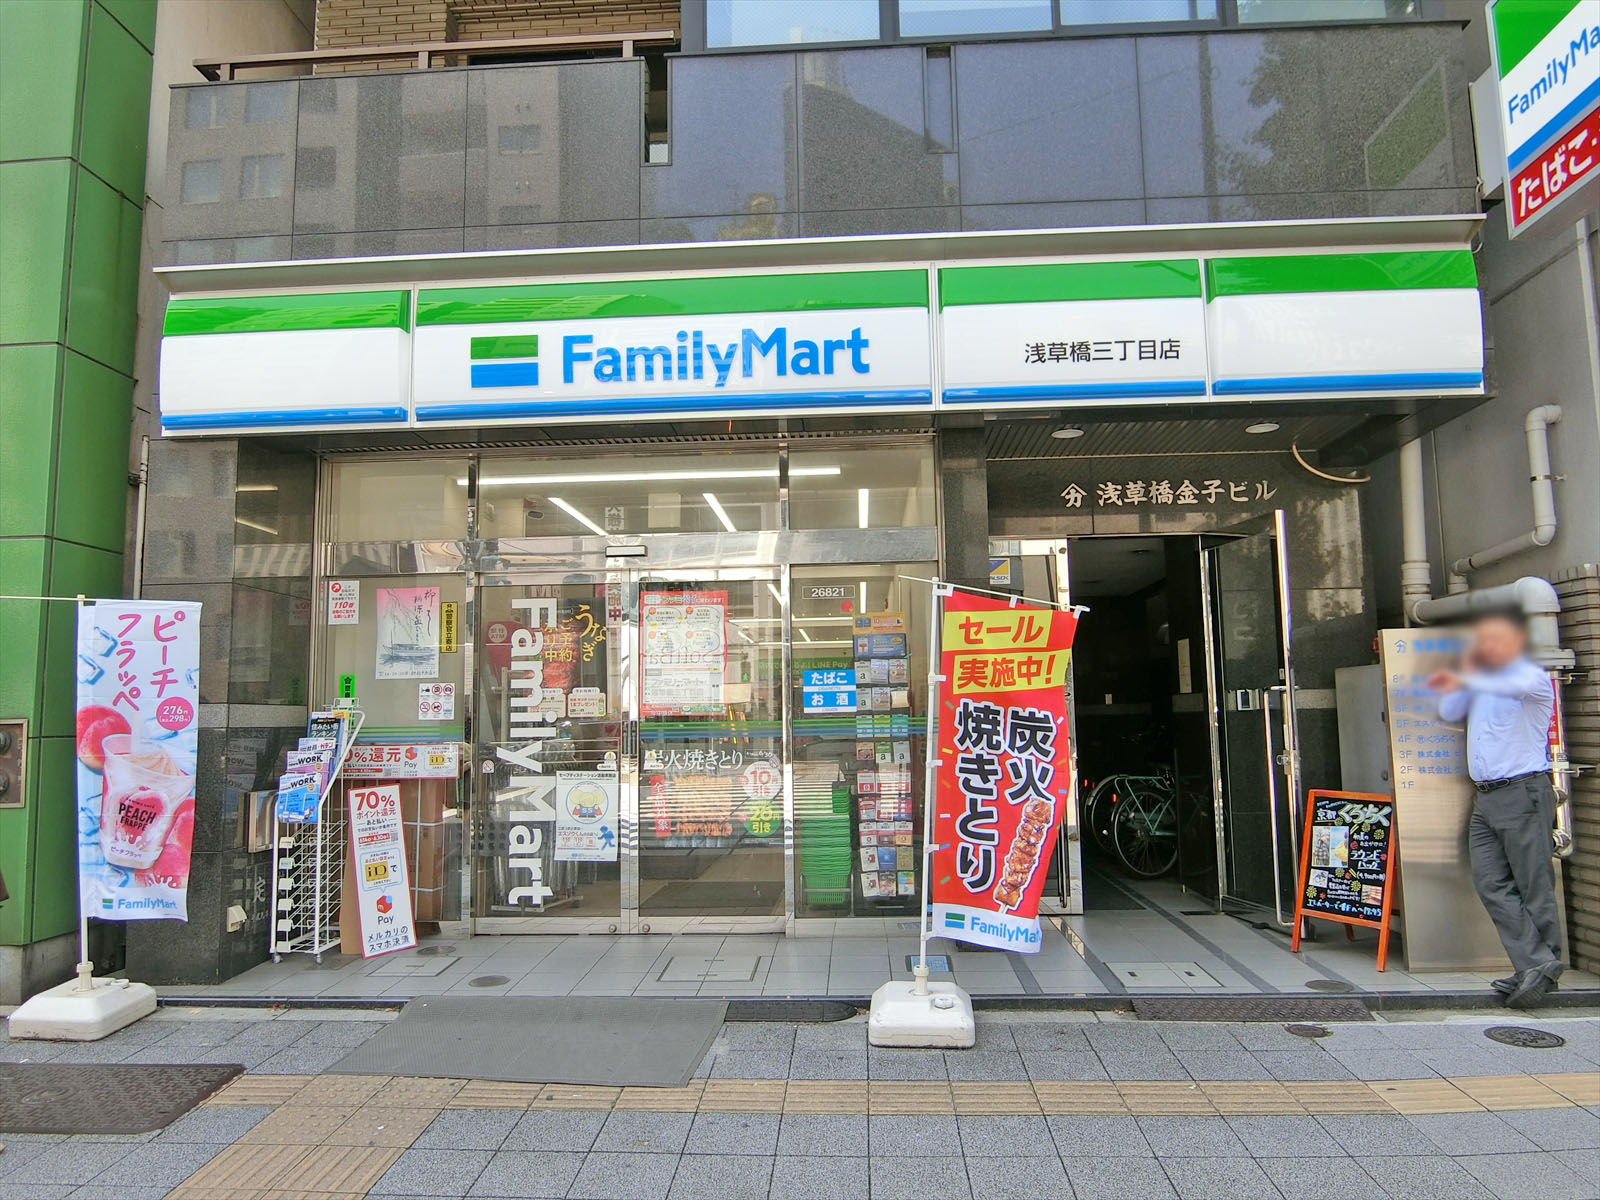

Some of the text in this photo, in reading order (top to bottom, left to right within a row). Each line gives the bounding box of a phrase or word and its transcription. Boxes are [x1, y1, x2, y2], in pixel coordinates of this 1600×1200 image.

[563, 326, 870, 388] FamilyMart
[1024, 339, 1182, 364] 浅草橋三丁目店
[1097, 480, 1279, 507] 浅草橋金子ビル
[811, 587, 845, 598] 26821
[575, 604, 608, 662] うなぎ
[958, 615, 1044, 645] セール
[560, 617, 574, 662] ご予約
[150, 610, 186, 699] ピーチ
[112, 613, 142, 712] フラッペ
[811, 671, 848, 685] たばこ
[957, 655, 1056, 690] 実施中!
[811, 692, 849, 706] お酒
[311, 730, 337, 738] ランキング
[1398, 735, 1411, 743] 4F
[497, 597, 558, 905] FamilyMart
[1006, 709, 1054, 802] 炭火
[1400, 750, 1413, 759] 3F
[1417, 750, 1450, 758] 株式会社
[297, 755, 323, 765] WORK
[403, 760, 418, 769] Pay
[1400, 766, 1413, 775] 2F
[1418, 766, 1451, 774] 株式会社
[290, 775, 317, 789] WORK
[1401, 781, 1414, 789] 1F
[354, 791, 396, 811] 70%
[957, 700, 1002, 890] 焼きとり
[118, 803, 157, 824] PEACH
[356, 807, 397, 821] ポイント還元
[1316, 803, 1392, 827] 京都 くろちく
[120, 816, 148, 831] FRAPPE
[366, 818, 388, 826] あと払い
[752, 821, 772, 833] 引き
[1351, 850, 1381, 860] ラウンド
[367, 864, 387, 877] iD
[117, 897, 178, 910] FamilyMart
[377, 915, 394, 925] Pay
[368, 926, 409, 943] メルカリの
[369, 935, 410, 952] スマホ決済
